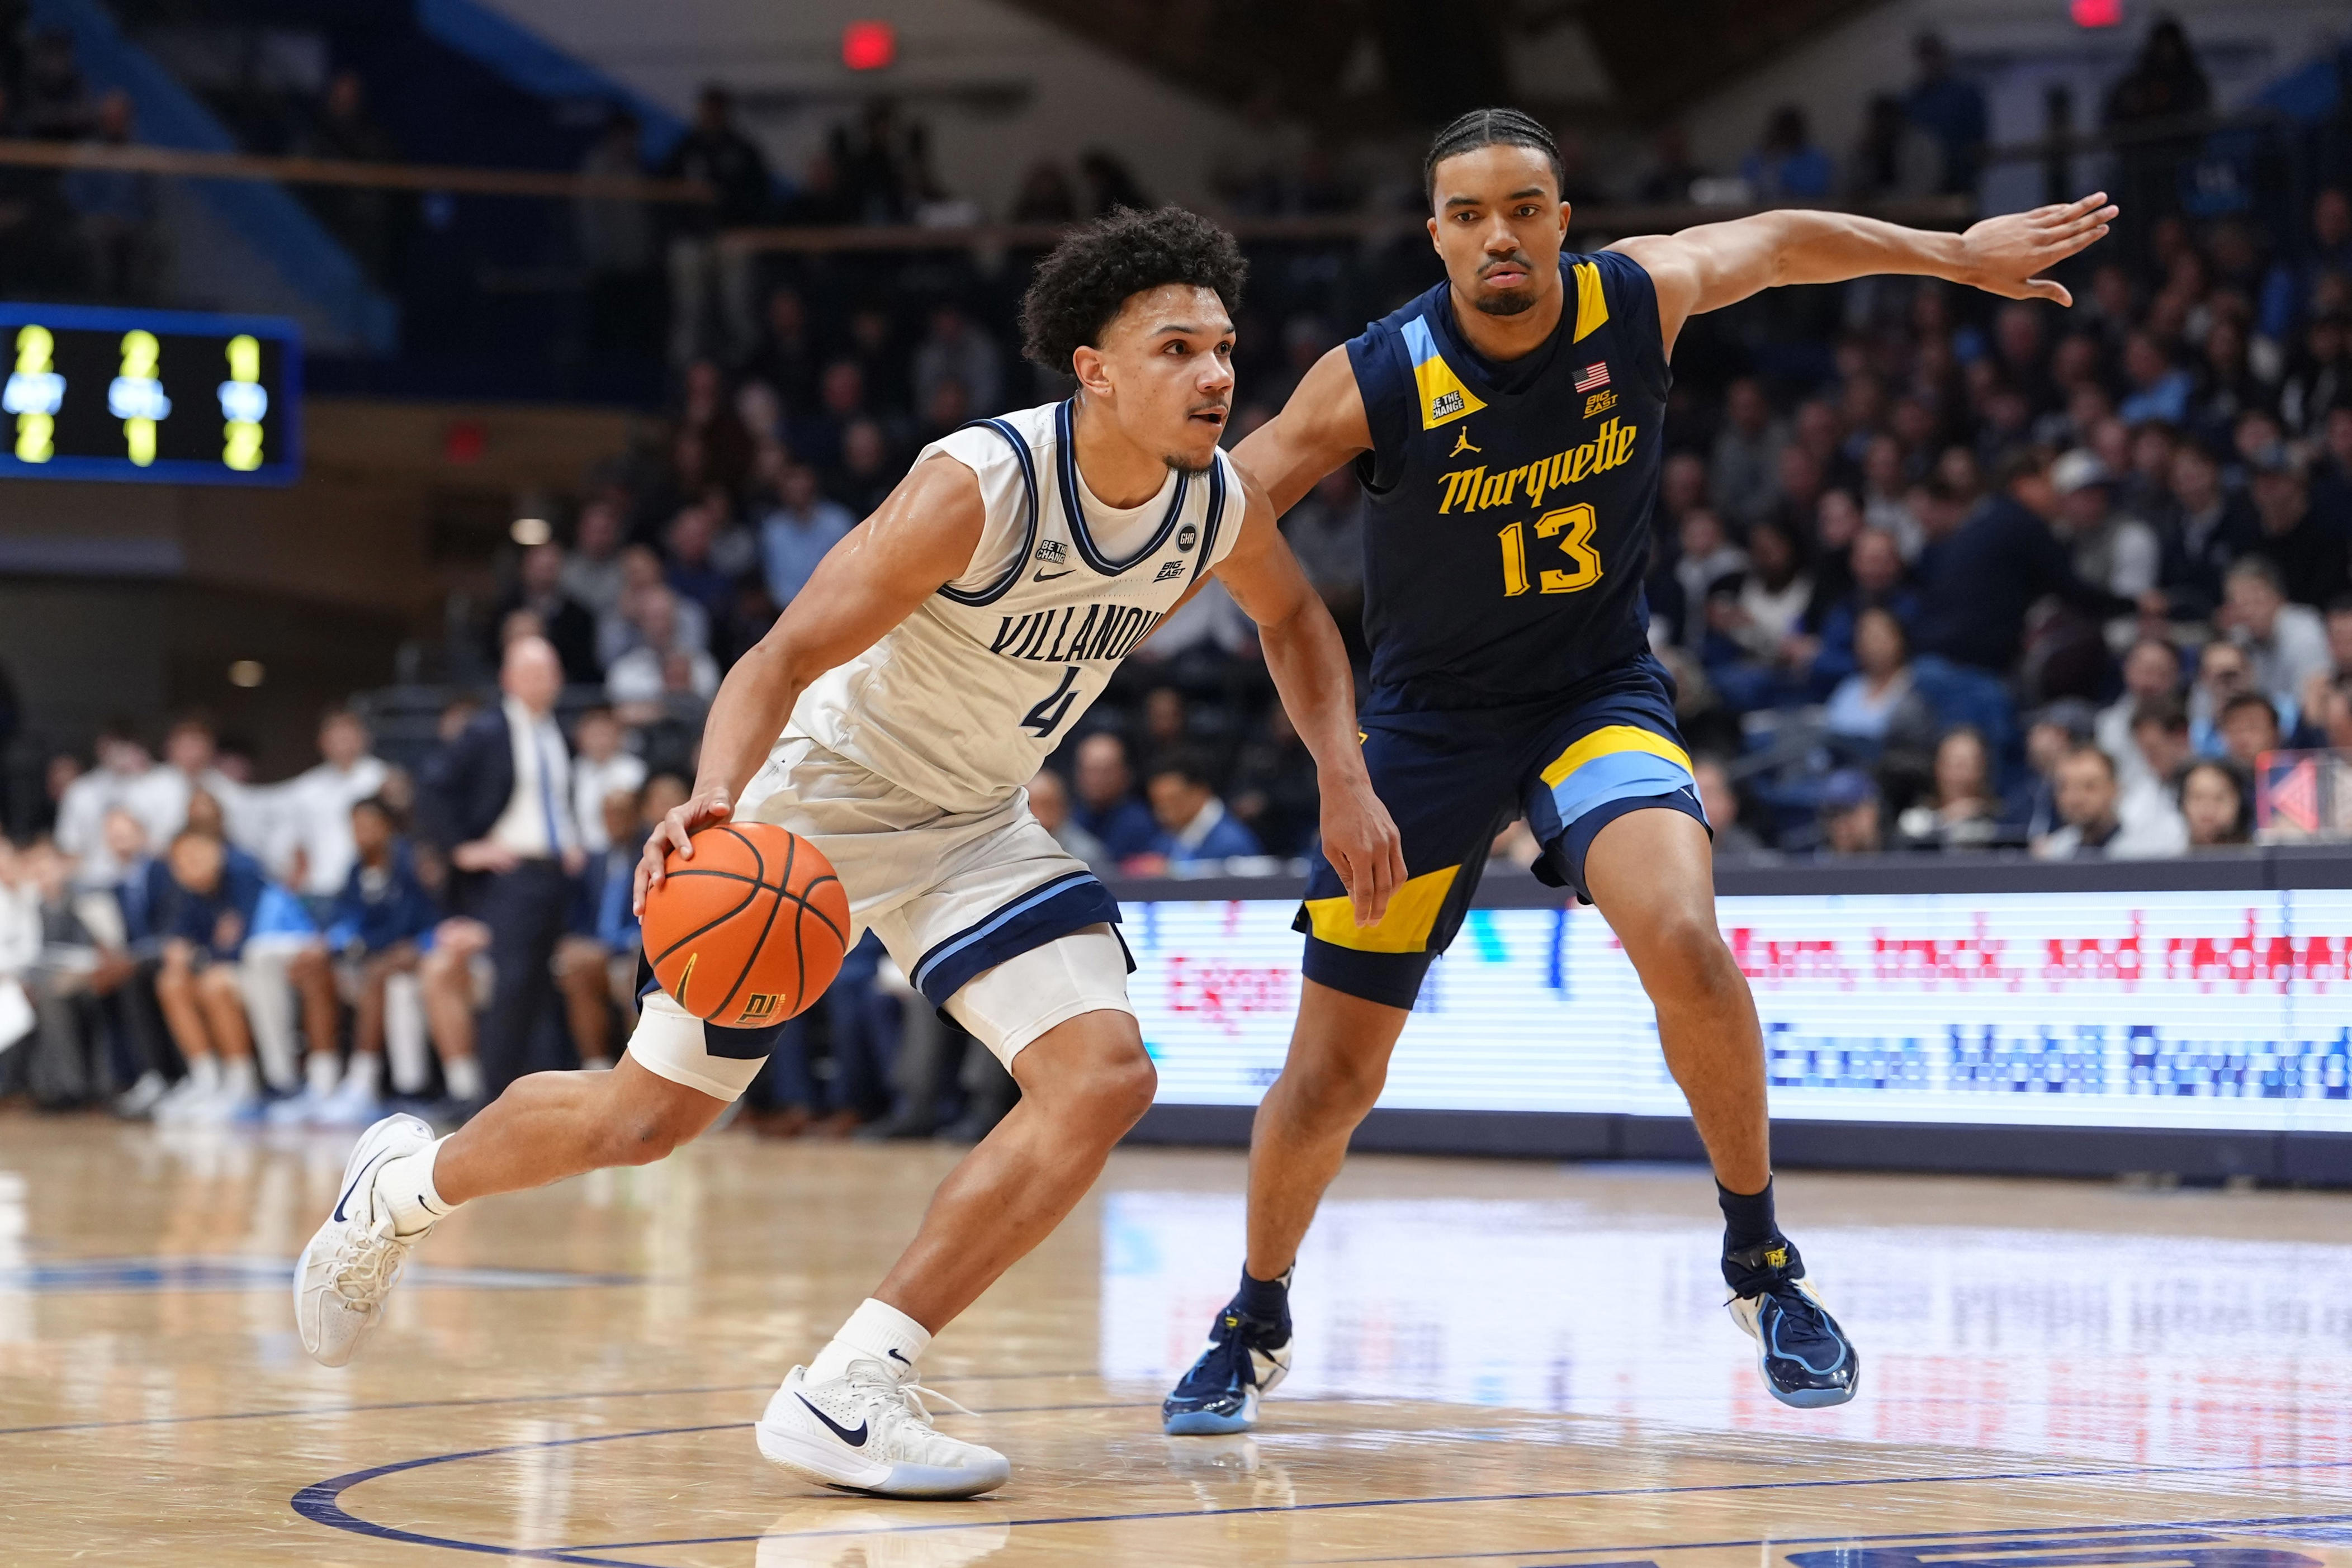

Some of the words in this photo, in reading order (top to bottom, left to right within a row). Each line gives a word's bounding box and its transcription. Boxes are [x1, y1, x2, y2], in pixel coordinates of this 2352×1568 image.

[1432, 397, 1441, 410] BE
[1442, 391, 1460, 404] THE
[1584, 394, 1619, 414] EAST
[1586, 390, 1610, 406] BIG
[1432, 399, 1464, 419] CHANGE
[1438, 416, 1637, 514] Marquette
[1180, 532, 1195, 545] GHR
[1042, 541, 1056, 551] BE
[1056, 543, 1068, 555] TH
[1497, 502, 1604, 597] 13
[1037, 549, 1066, 565] CHANG
[1162, 560, 1183, 570] BIG
[1156, 567, 1186, 578] EAST
[1019, 665, 1082, 738] 4
